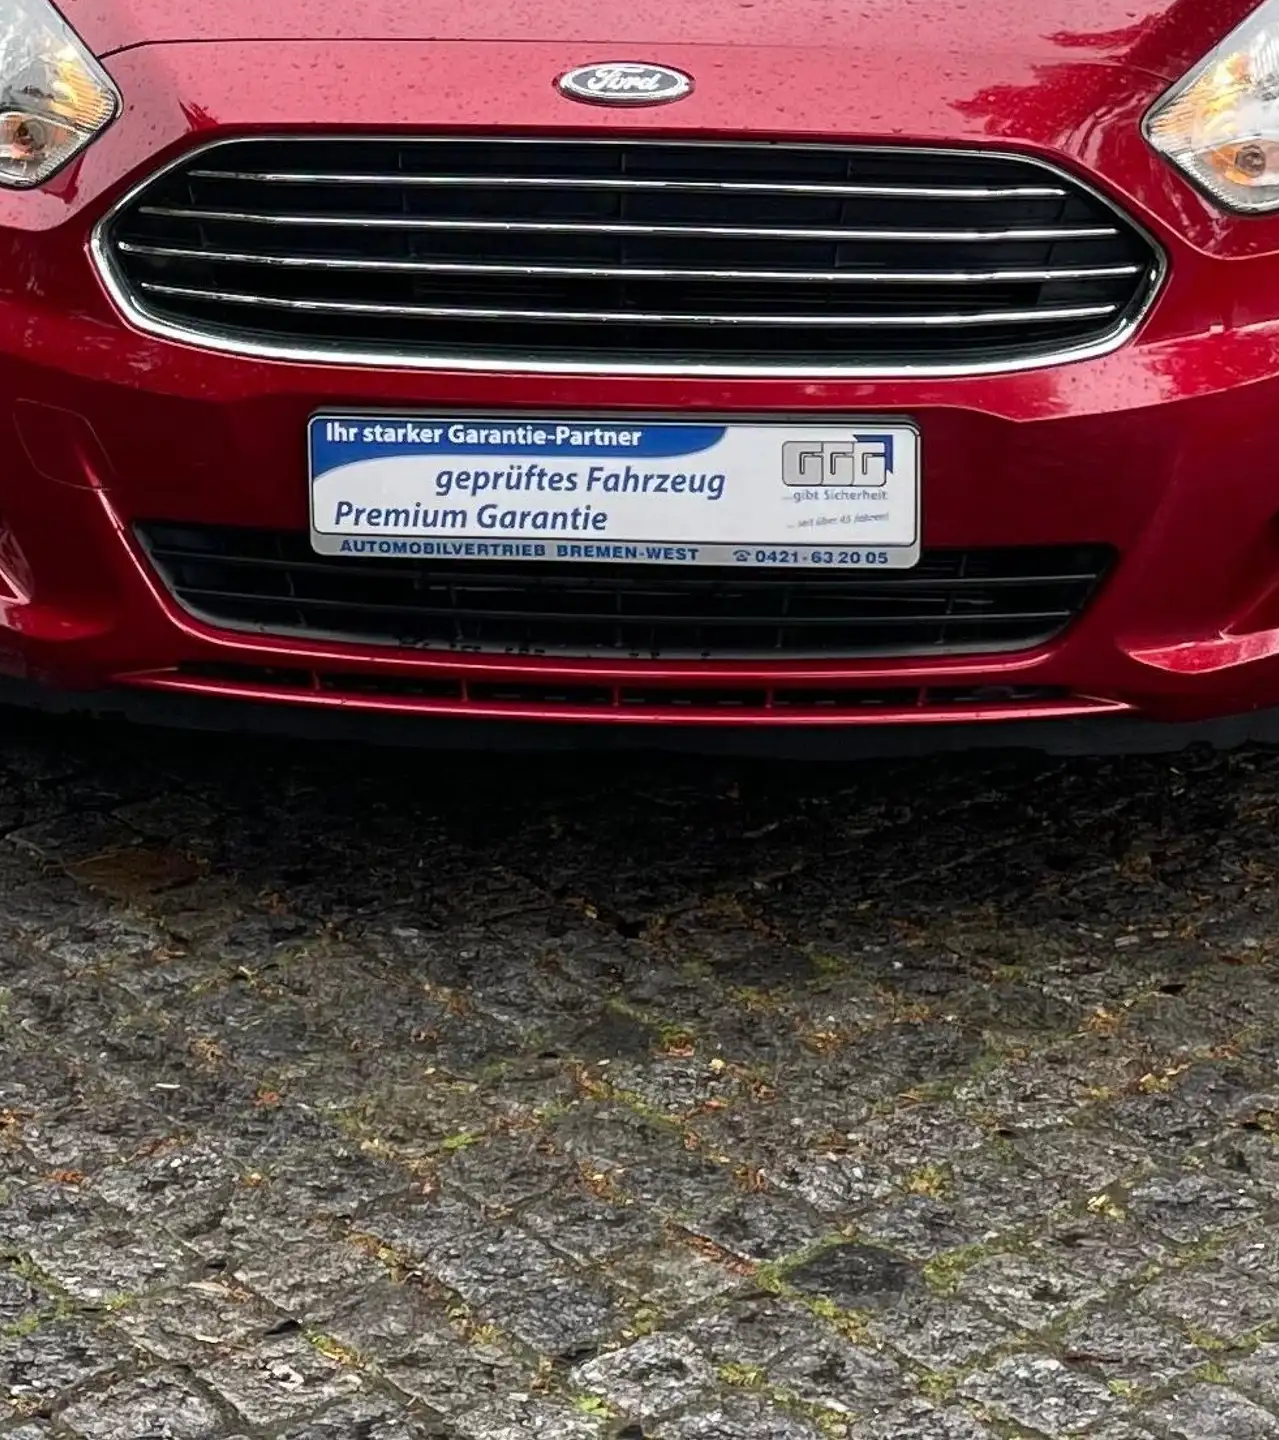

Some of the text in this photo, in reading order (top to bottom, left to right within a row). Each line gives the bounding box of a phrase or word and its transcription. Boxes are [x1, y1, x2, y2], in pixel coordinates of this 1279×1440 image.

[587, 68, 662, 91] Ford
[326, 422, 642, 447] Ihr starker Garantie-Partner
[436, 464, 725, 500] geprüftes Fahrzeug
[335, 501, 608, 531] Premium Garantie
[340, 539, 546, 557] AUTOMOBILVERTRIEB
[557, 544, 699, 560] BREMEN-WEST
[838, 551, 862, 564] 20
[865, 552, 889, 564] 05
